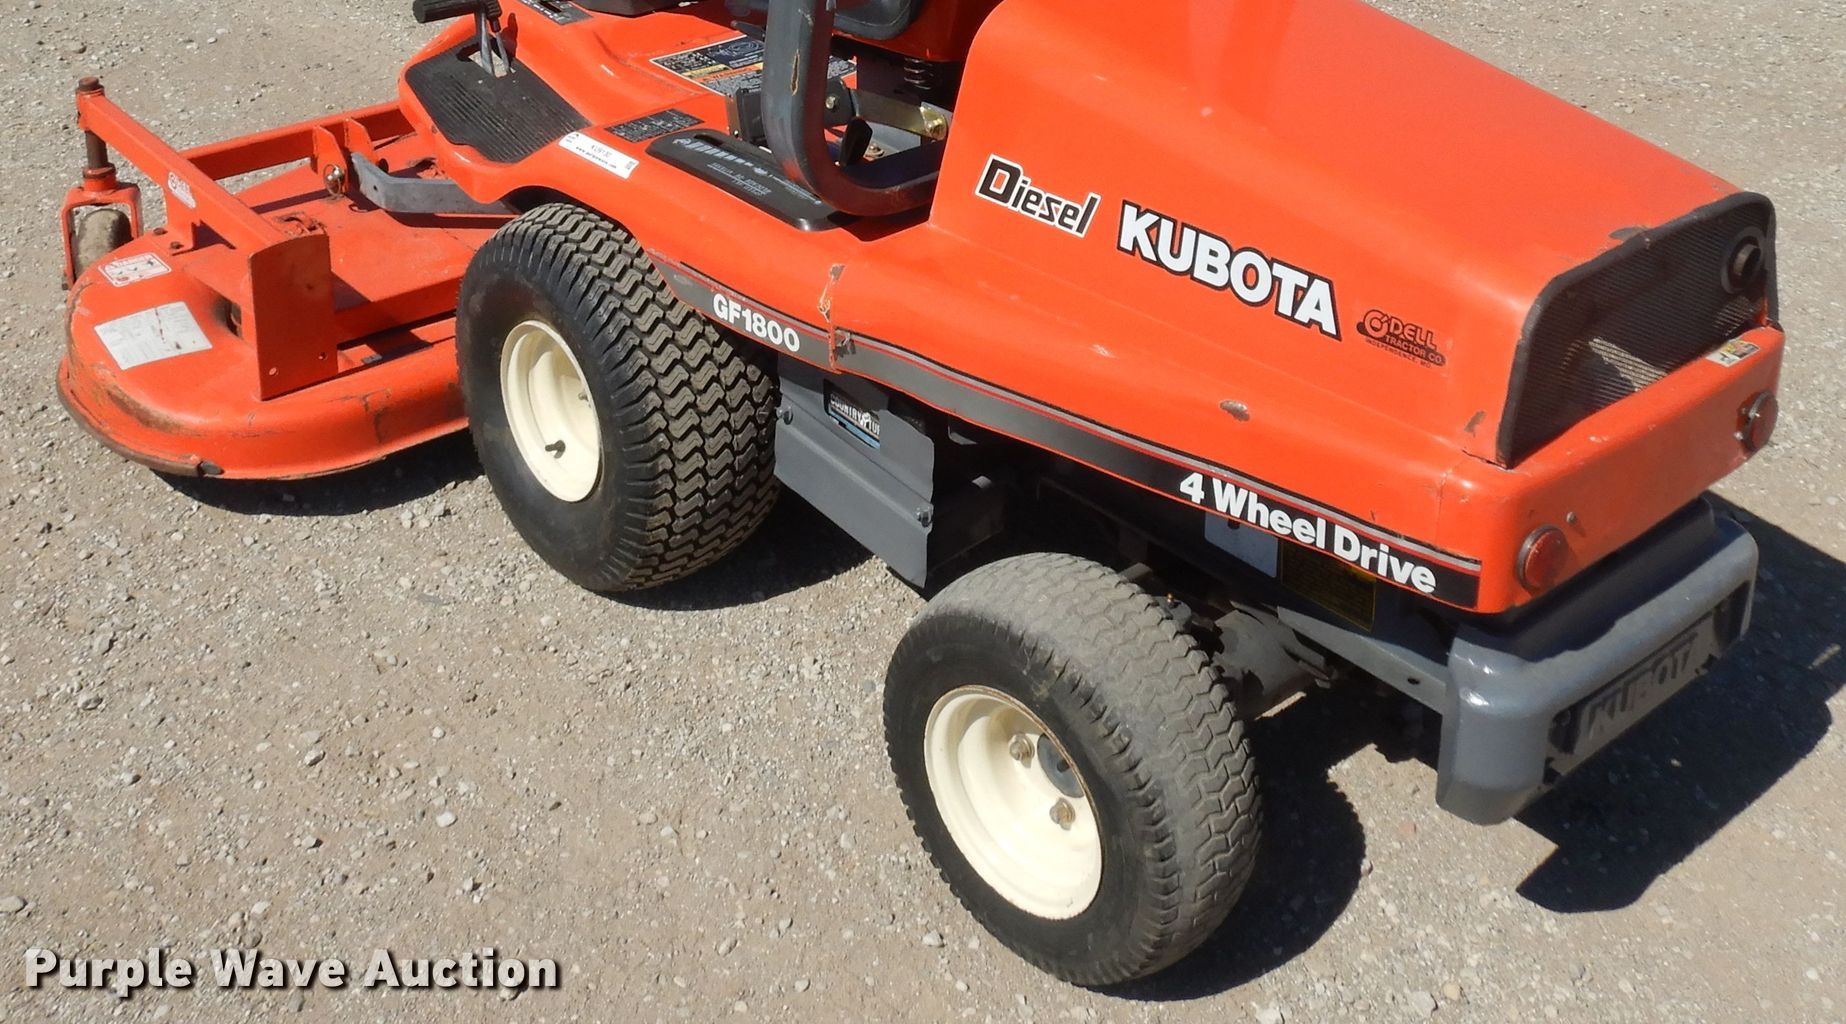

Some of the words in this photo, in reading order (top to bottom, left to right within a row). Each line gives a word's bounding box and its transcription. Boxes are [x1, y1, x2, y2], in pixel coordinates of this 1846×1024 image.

[976, 154, 1101, 237] Diesel
[1118, 201, 1341, 340] KUBOTA
[713, 293, 800, 353] GF1800
[1385, 334, 1427, 358] TRACTOR
[1179, 472, 1205, 504] 4
[1212, 477, 1326, 549] Wheel
[1333, 524, 1437, 594] Drive
